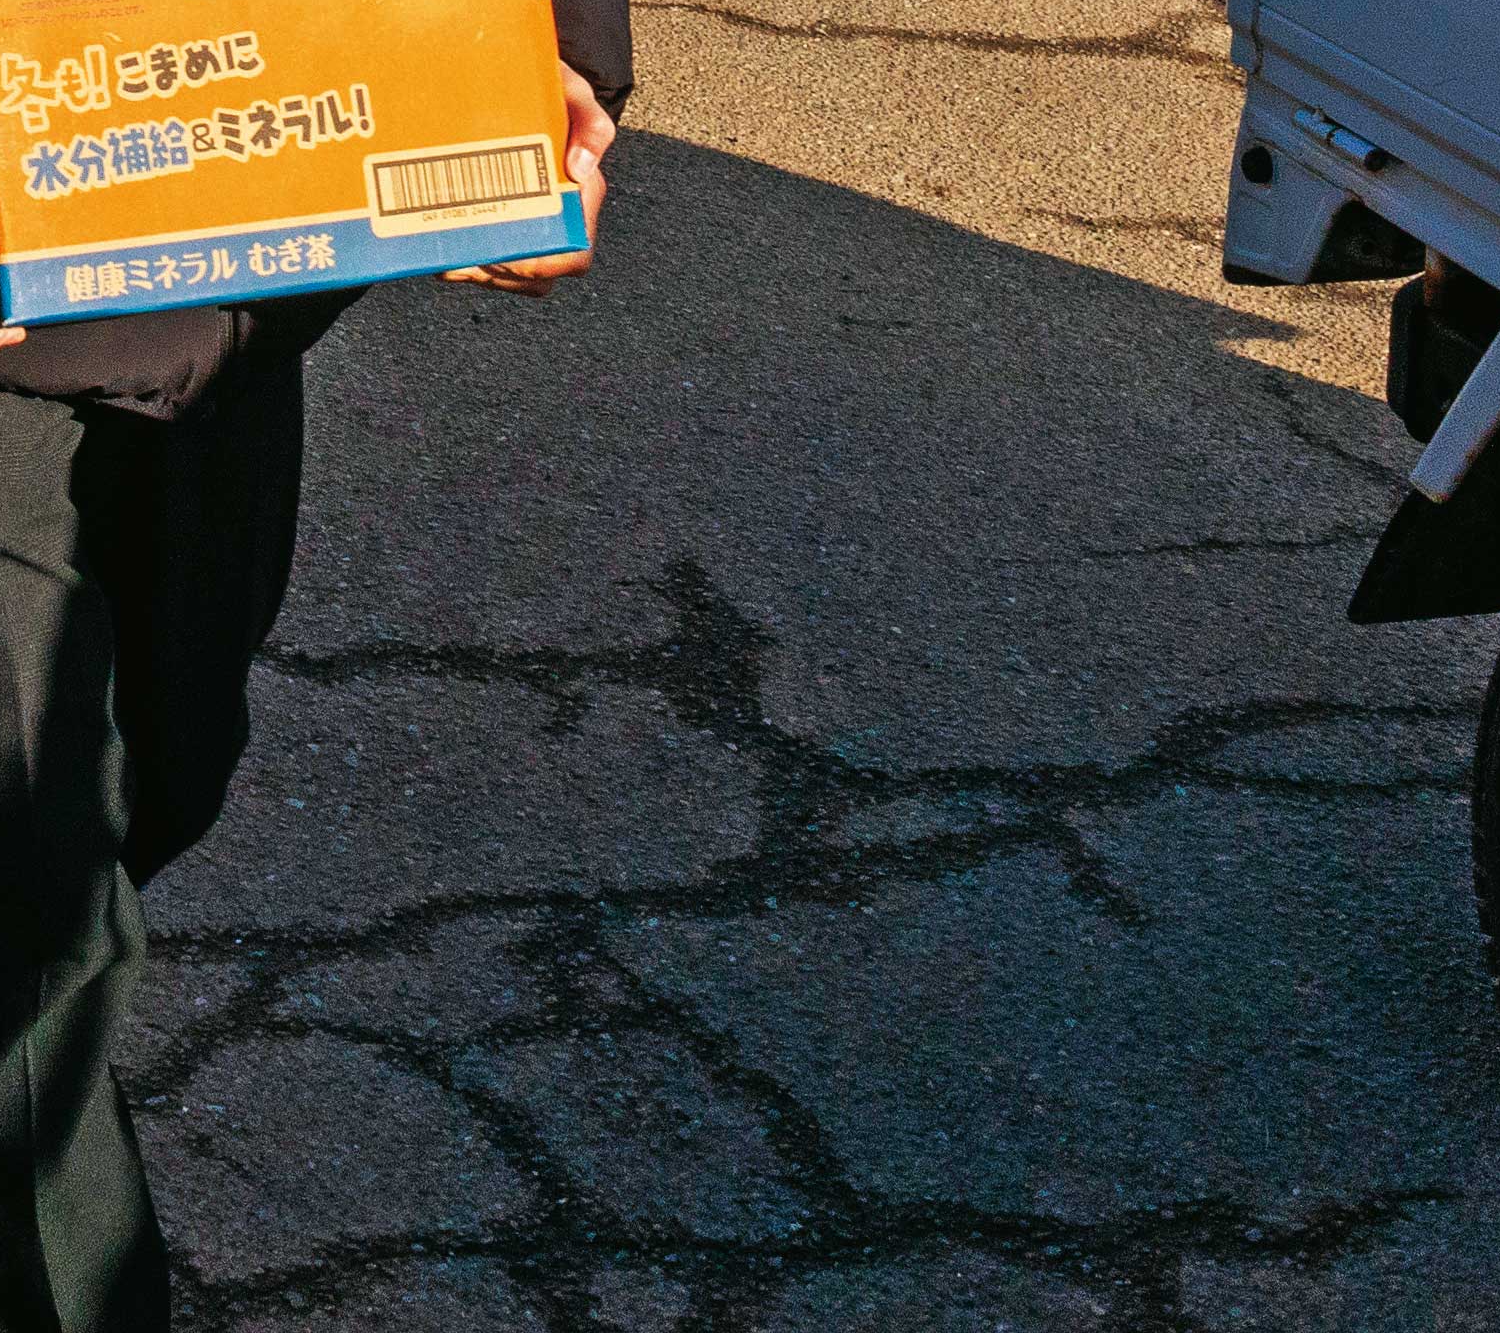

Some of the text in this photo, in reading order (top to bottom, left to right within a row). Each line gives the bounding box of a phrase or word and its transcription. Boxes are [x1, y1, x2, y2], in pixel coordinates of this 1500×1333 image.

[120, 35, 260, 94] こまめに
[64, 234, 336, 303] 健康ミネラル むぎ茶
